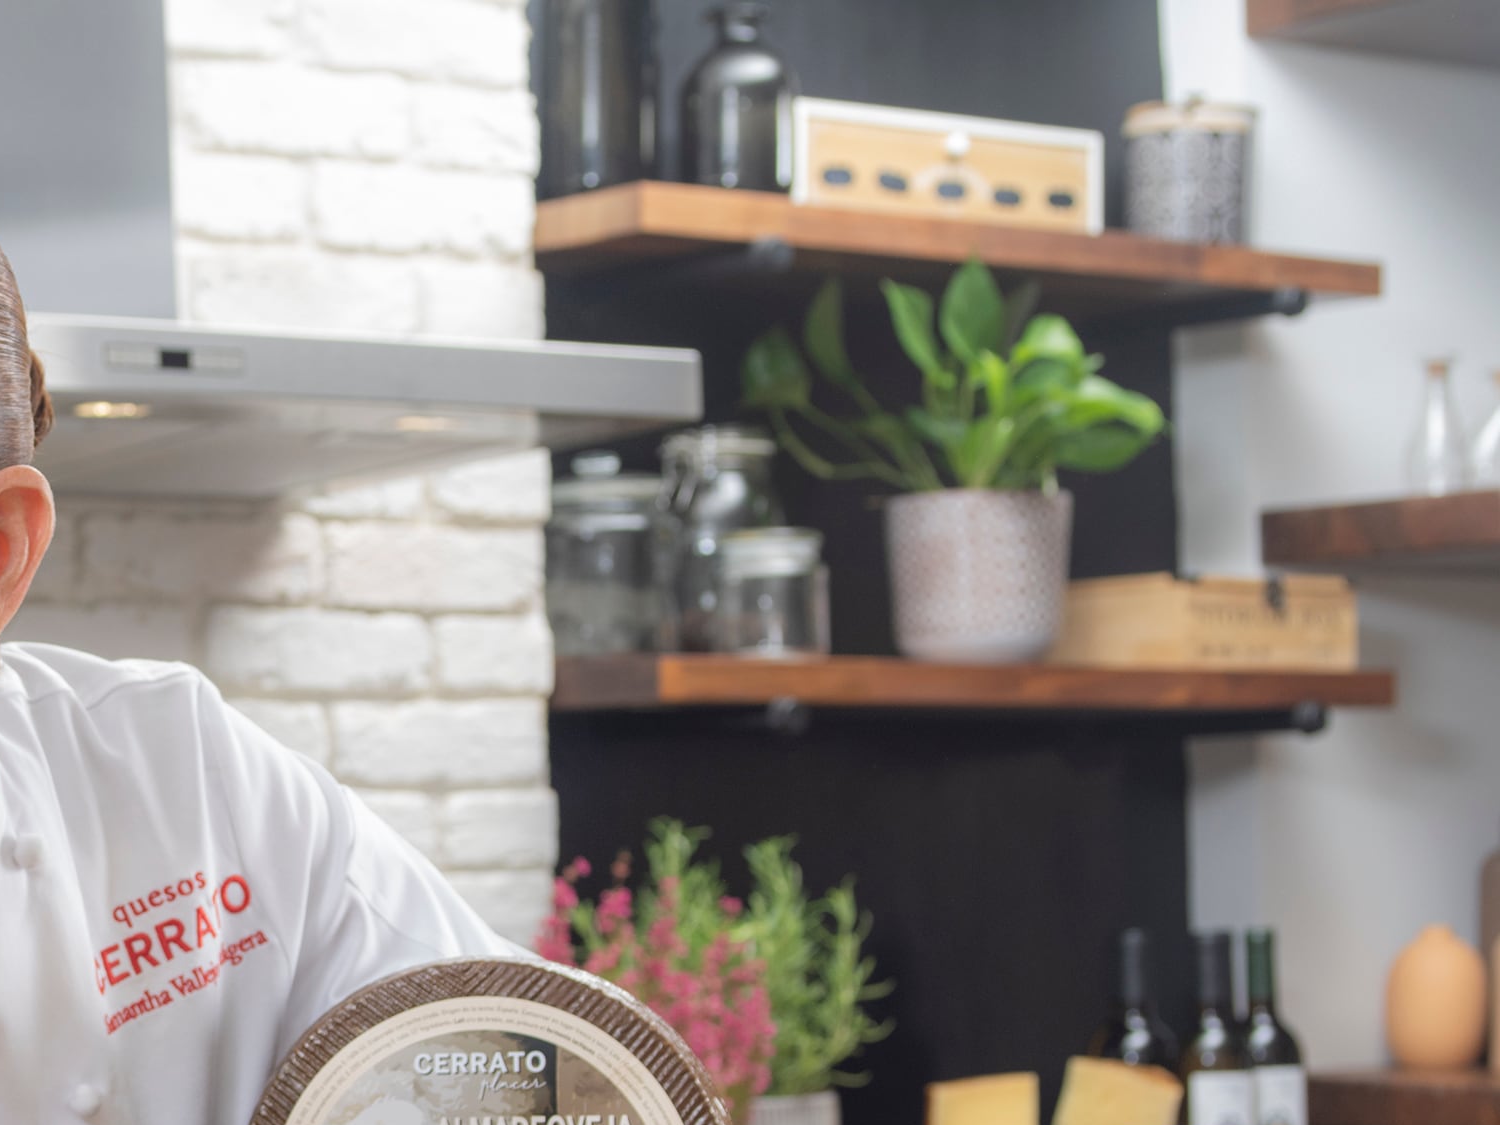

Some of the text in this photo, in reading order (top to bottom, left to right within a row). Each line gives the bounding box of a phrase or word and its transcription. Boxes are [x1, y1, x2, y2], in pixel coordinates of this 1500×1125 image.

[111, 871, 207, 929] quesos
[94, 874, 251, 996] ERRAO
[413, 1050, 547, 1076] CERRATO
[481, 1070, 547, 1101] placer
